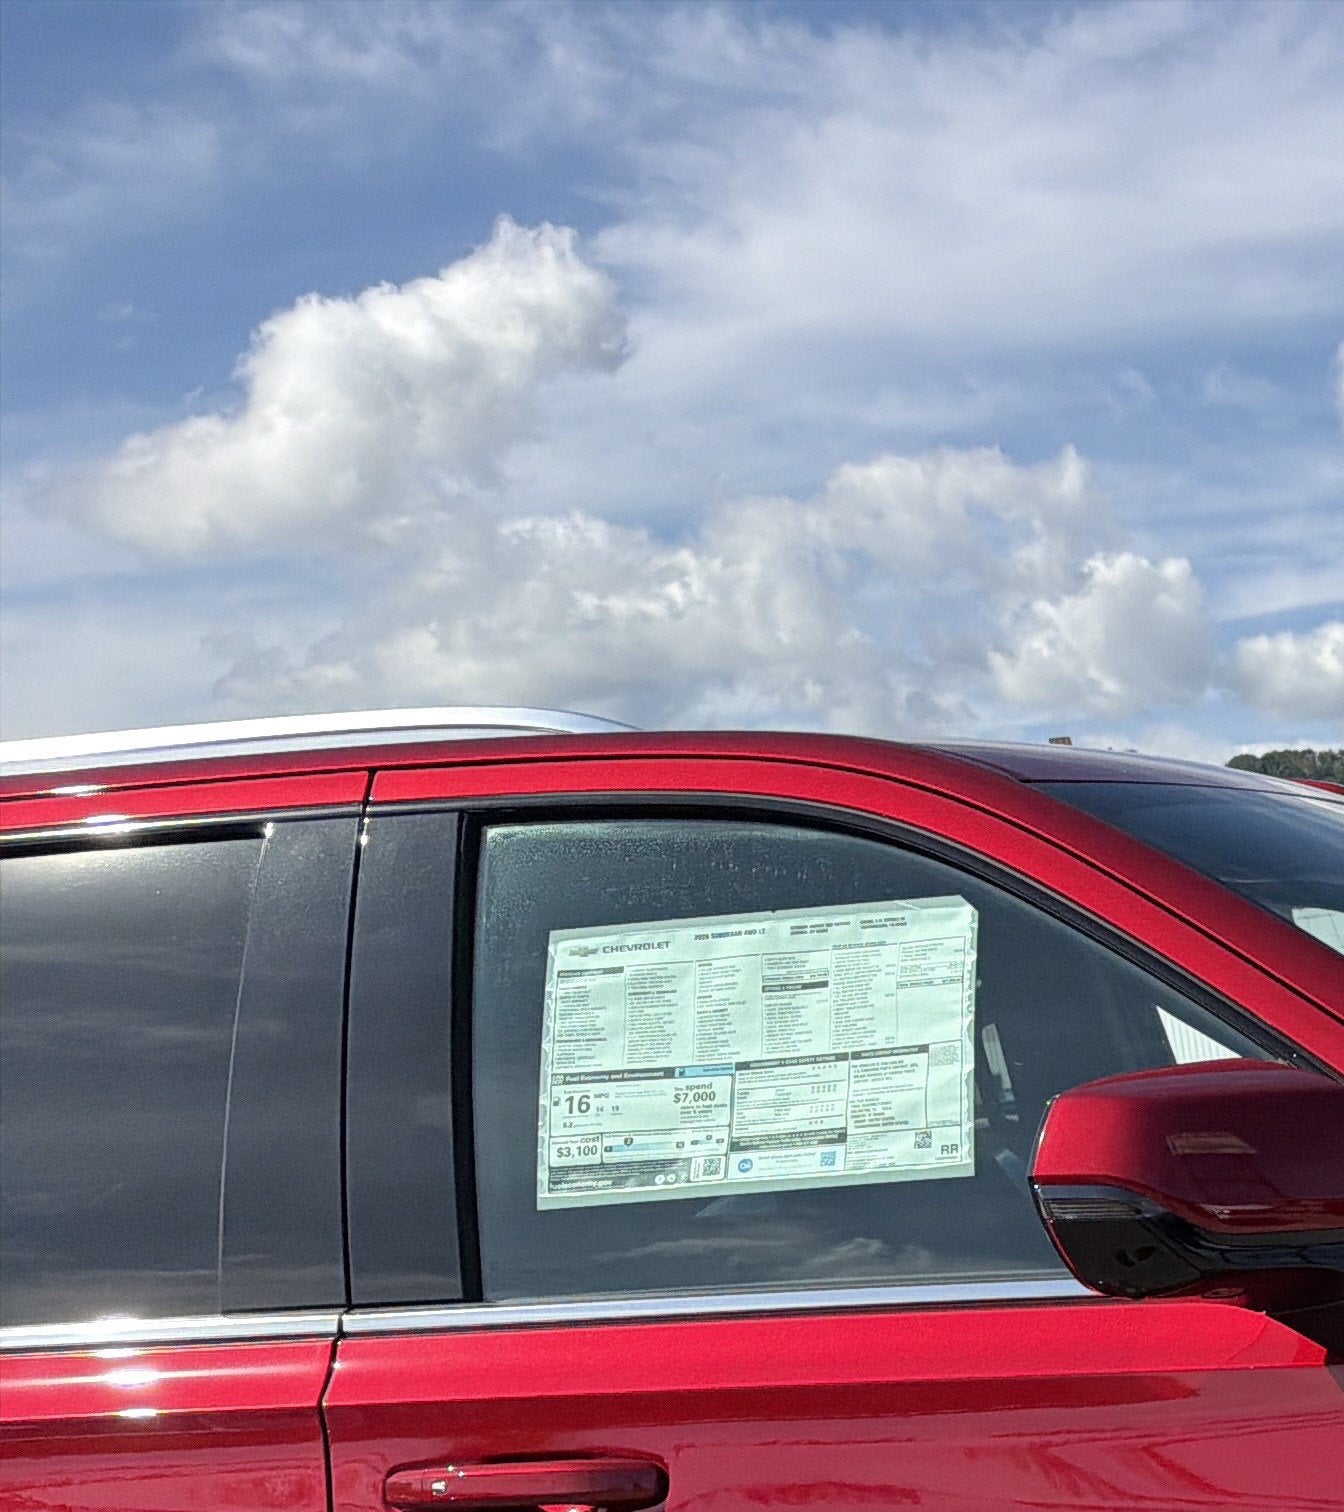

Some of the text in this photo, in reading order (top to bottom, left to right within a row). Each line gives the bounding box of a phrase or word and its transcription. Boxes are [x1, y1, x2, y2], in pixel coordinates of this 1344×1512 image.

[602, 940, 671, 955] CHEVROLET
[685, 1082, 713, 1092] spend
[673, 1091, 716, 1104] $7,000
[564, 1095, 591, 1115] 16
[556, 1145, 598, 1159] $3,100
[941, 1143, 959, 1156] RR
